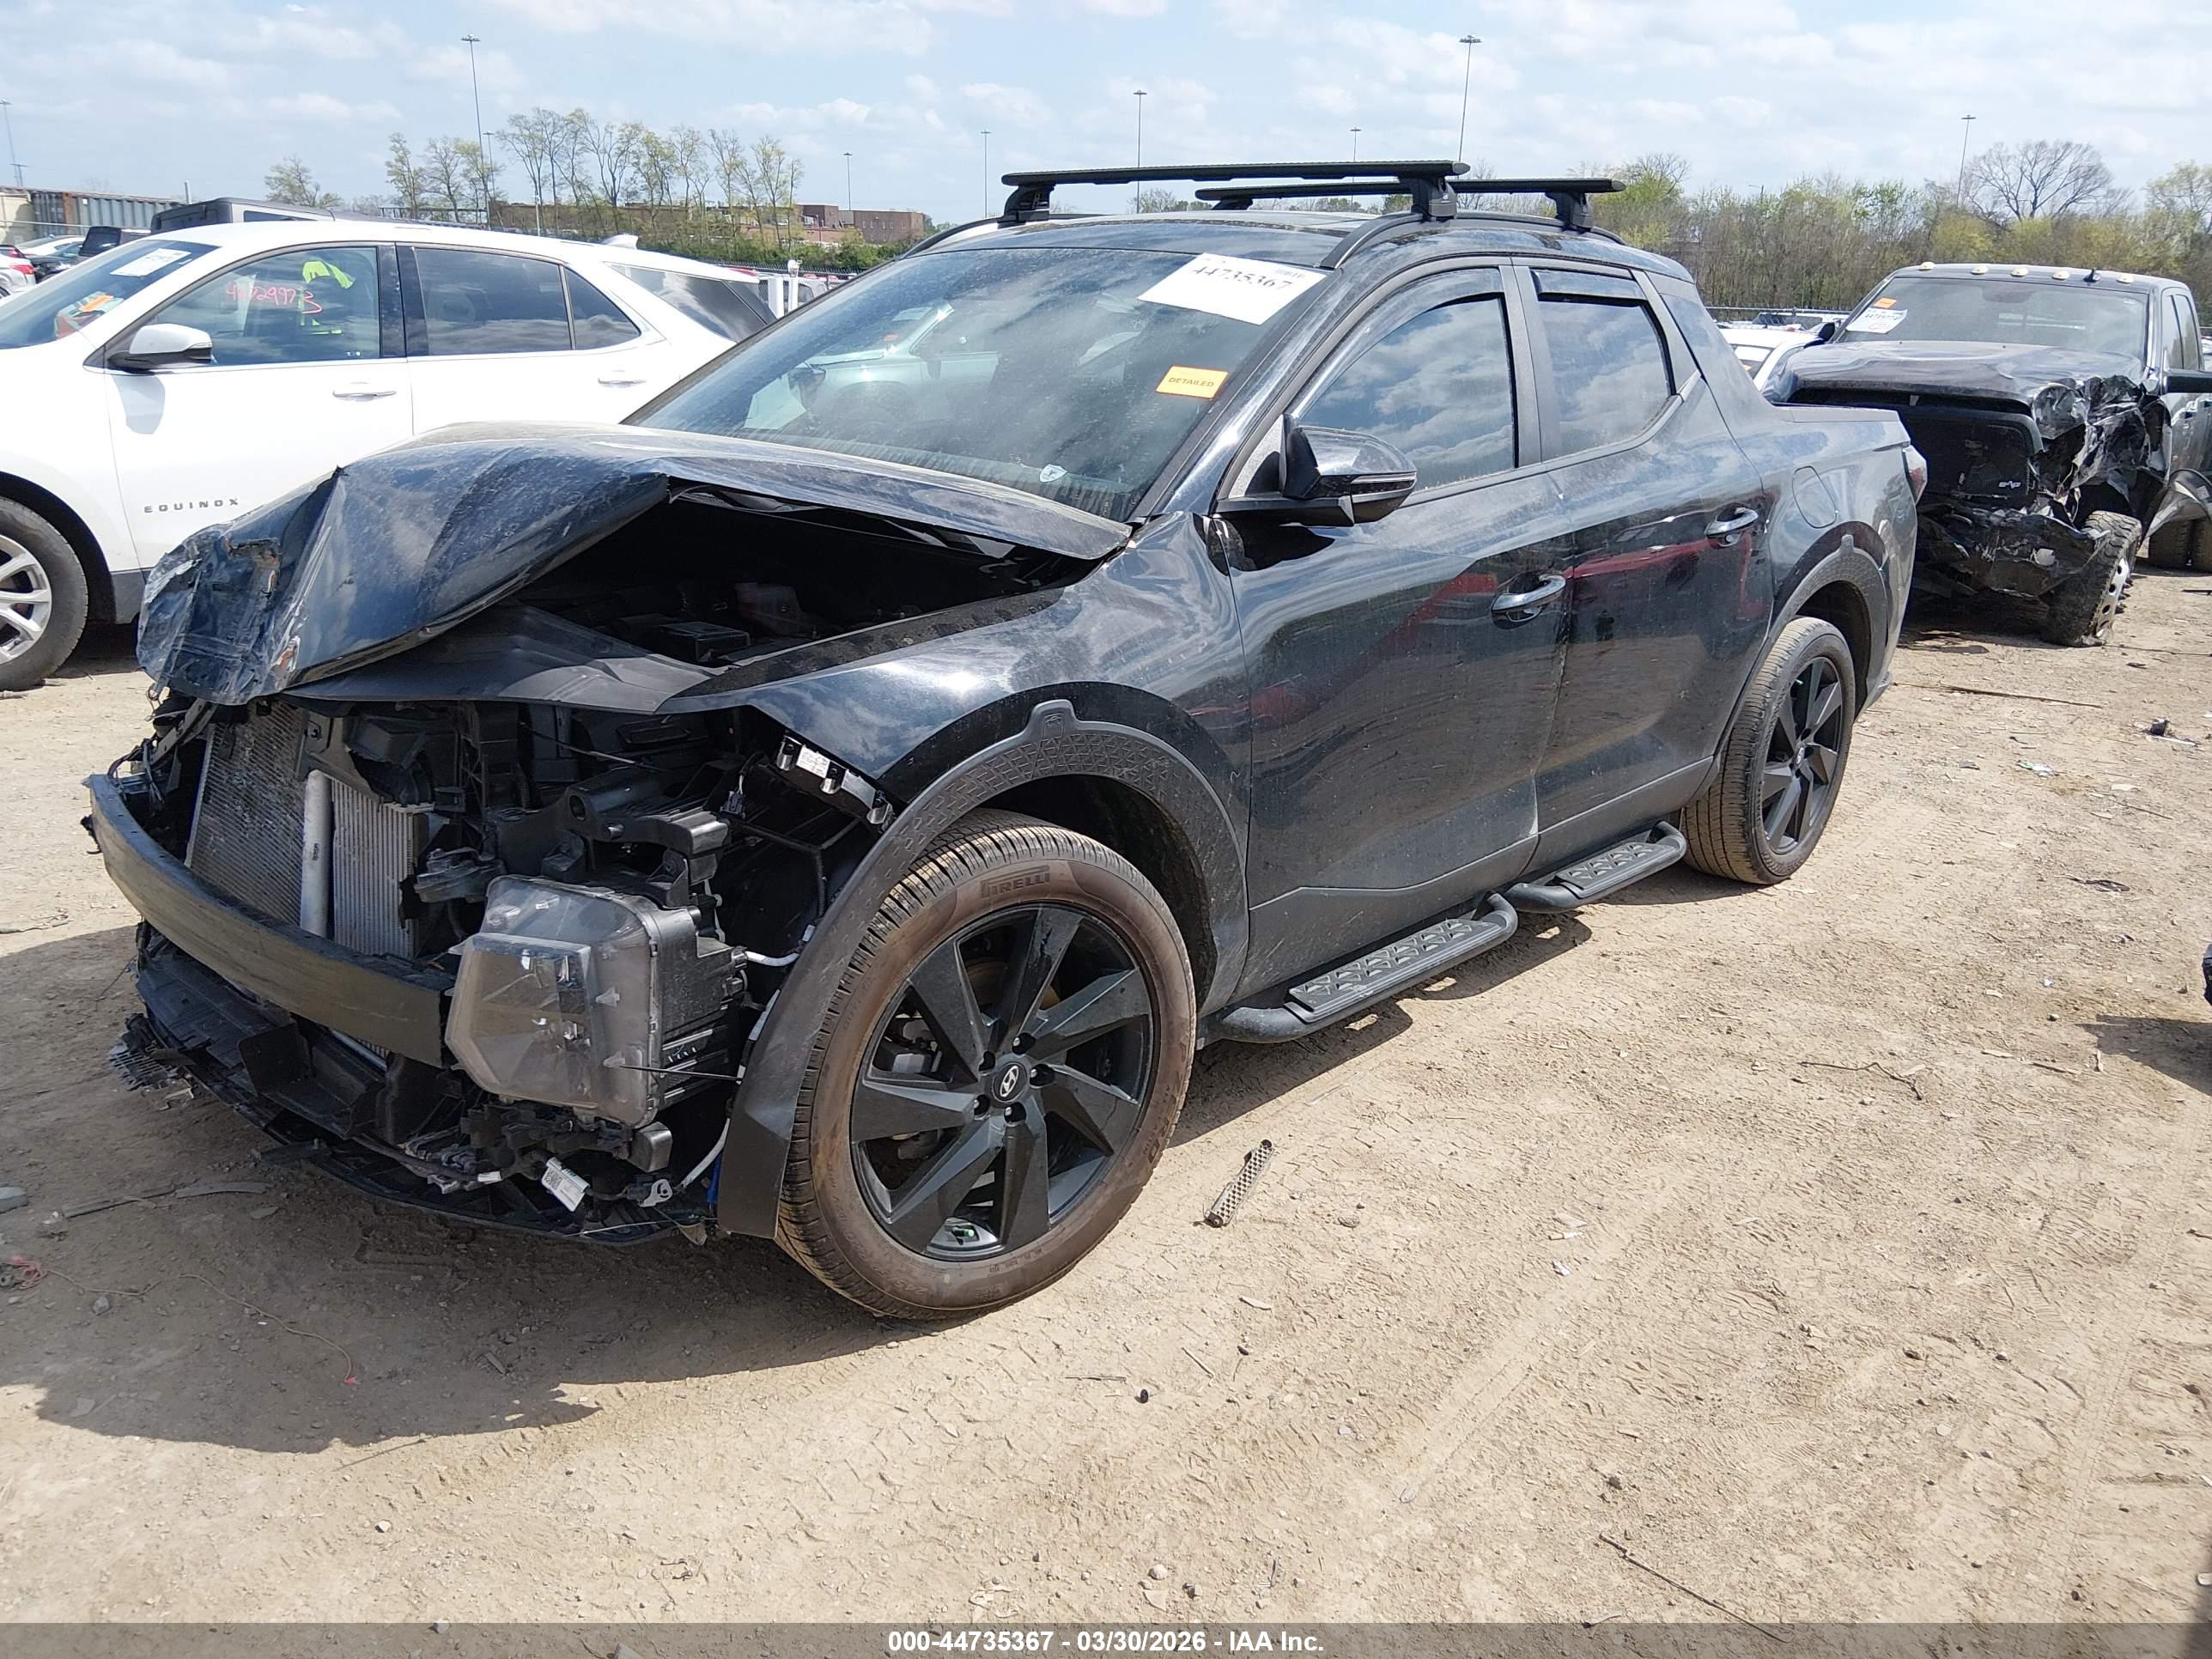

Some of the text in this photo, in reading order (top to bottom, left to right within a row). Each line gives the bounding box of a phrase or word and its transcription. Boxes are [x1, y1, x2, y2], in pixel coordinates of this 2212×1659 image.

[1191, 266, 1292, 289] 44735367
[1169, 377, 1214, 387] DETAILED
[143, 498, 239, 514] EQUINOX
[981, 865, 1050, 898] PIRELLI
